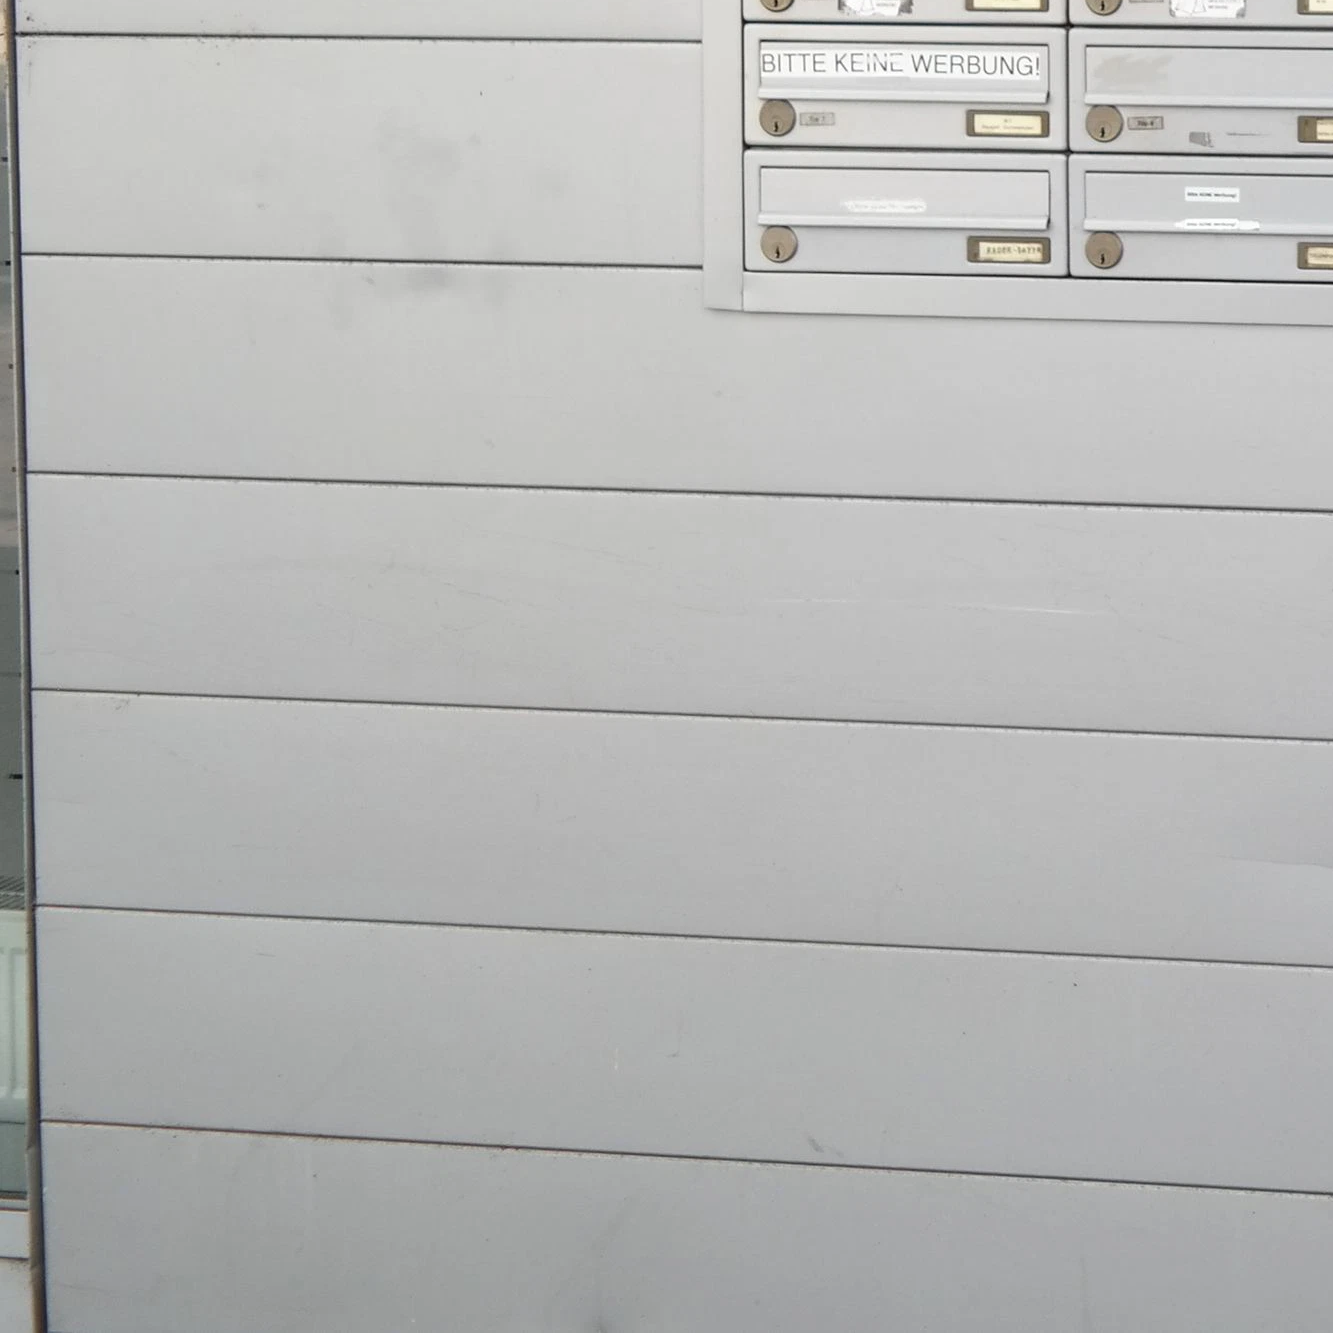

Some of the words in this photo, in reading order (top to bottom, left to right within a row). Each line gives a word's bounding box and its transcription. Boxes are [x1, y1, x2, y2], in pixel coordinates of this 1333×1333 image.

[762, 53, 826, 73] BITTE
[835, 53, 904, 73] KEINE
[911, 54, 1041, 77] WERBUNG!
